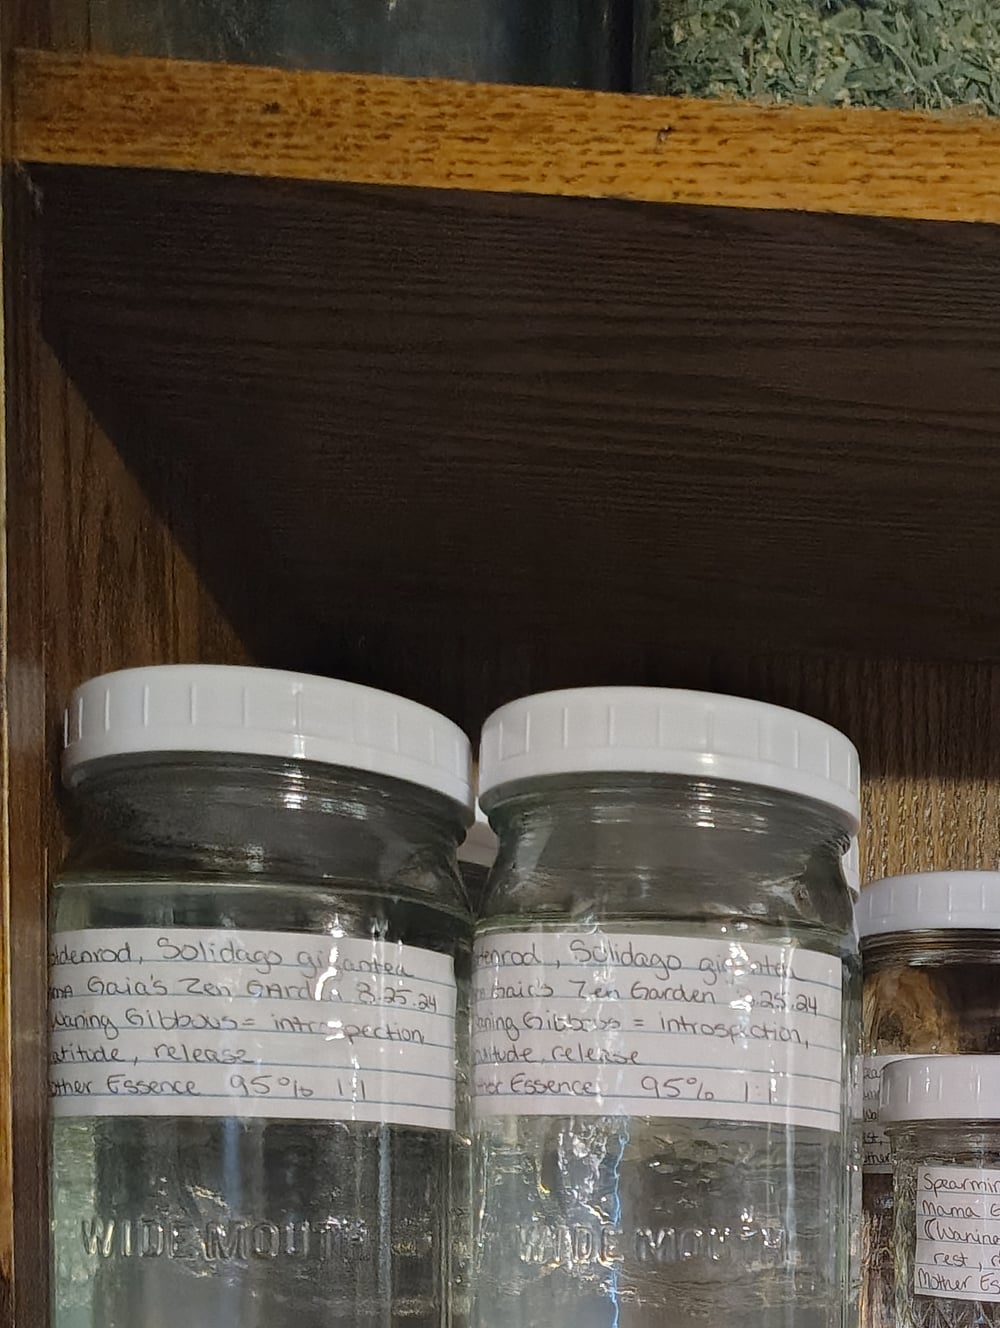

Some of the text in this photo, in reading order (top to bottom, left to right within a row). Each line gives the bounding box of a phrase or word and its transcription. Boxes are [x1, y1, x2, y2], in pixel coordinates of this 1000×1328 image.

[157, 937, 282, 974] Solidago
[87, 974, 167, 996] Gaia's
[178, 978, 231, 997] Zen
[568, 979, 620, 999] Zen
[631, 981, 716, 1004] Garden
[154, 1043, 254, 1064] release
[50, 1078, 92, 1096] other
[107, 1074, 200, 1096] Essence
[230, 1074, 313, 1098] 95%
[510, 1072, 597, 1096] Essence
[641, 1076, 714, 1100] 95%
[922, 1199, 981, 1218] Mama
[81, 1218, 196, 1260] WIDE
[918, 1267, 972, 1289] Mother
